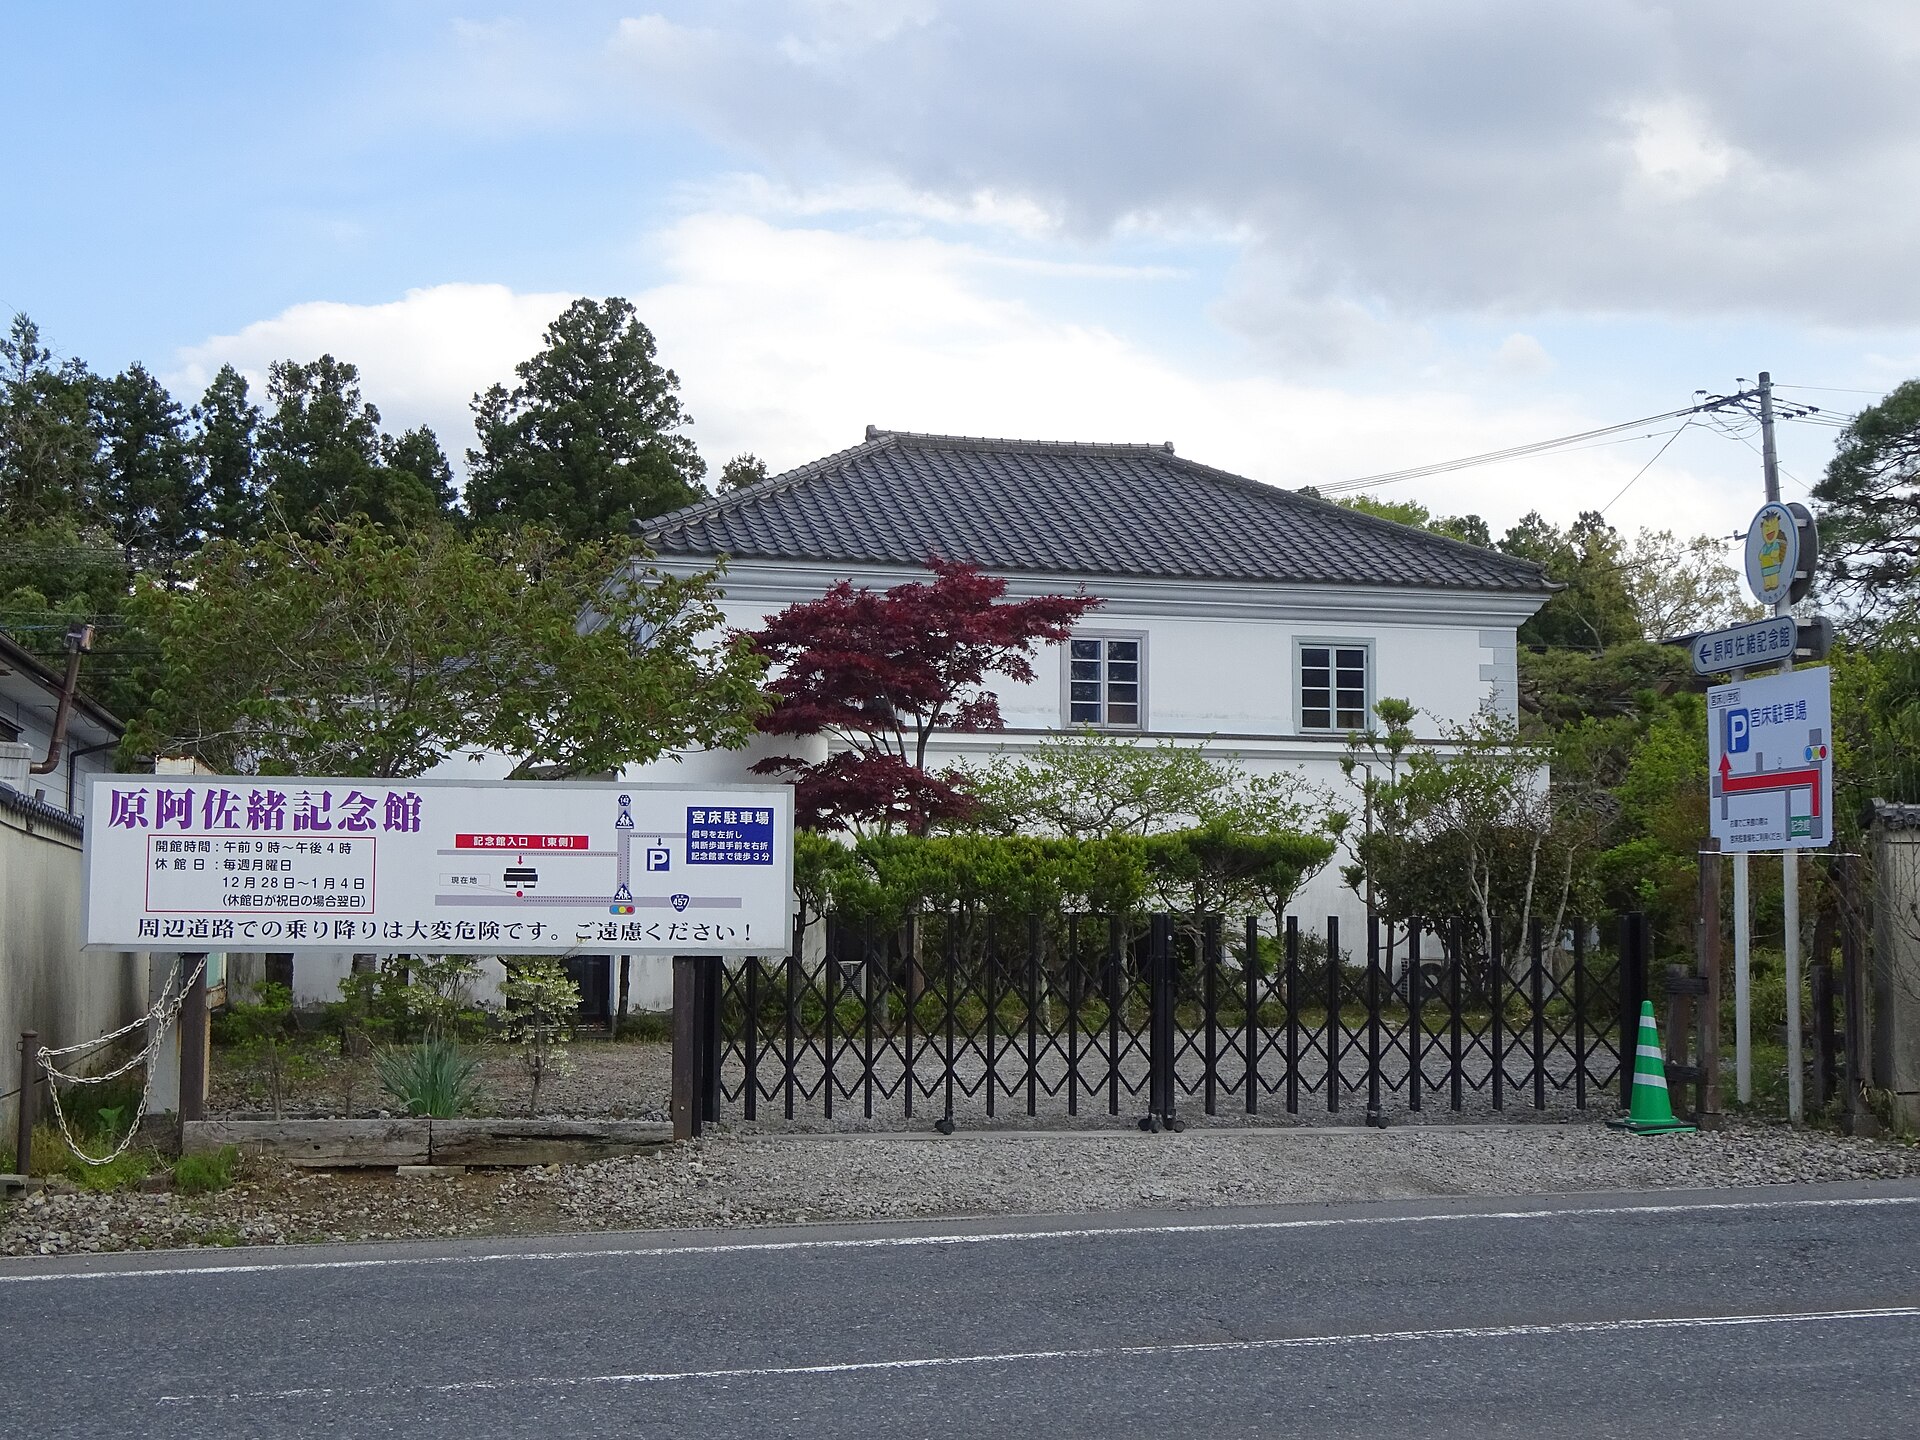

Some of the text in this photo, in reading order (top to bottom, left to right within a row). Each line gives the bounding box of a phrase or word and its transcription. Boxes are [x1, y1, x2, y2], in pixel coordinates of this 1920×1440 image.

[1713, 627, 1791, 662] 原阿佐緒記念館
[1750, 700, 1807, 727] 宮床駐車場
[1731, 716, 1747, 750] P
[108, 788, 423, 833] 原阿佐緒記念館
[691, 811, 770, 825] 宮床駐車場
[691, 830, 743, 839] 信号を左折し
[473, 836, 529, 847] 記念館入口
[691, 841, 769, 851] 横断歩道手前を右折
[649, 851, 668, 870] P
[691, 852, 770, 861] 記念館まで徒歩3分
[451, 876, 478, 885] 現在地
[673, 898, 688, 906] 457
